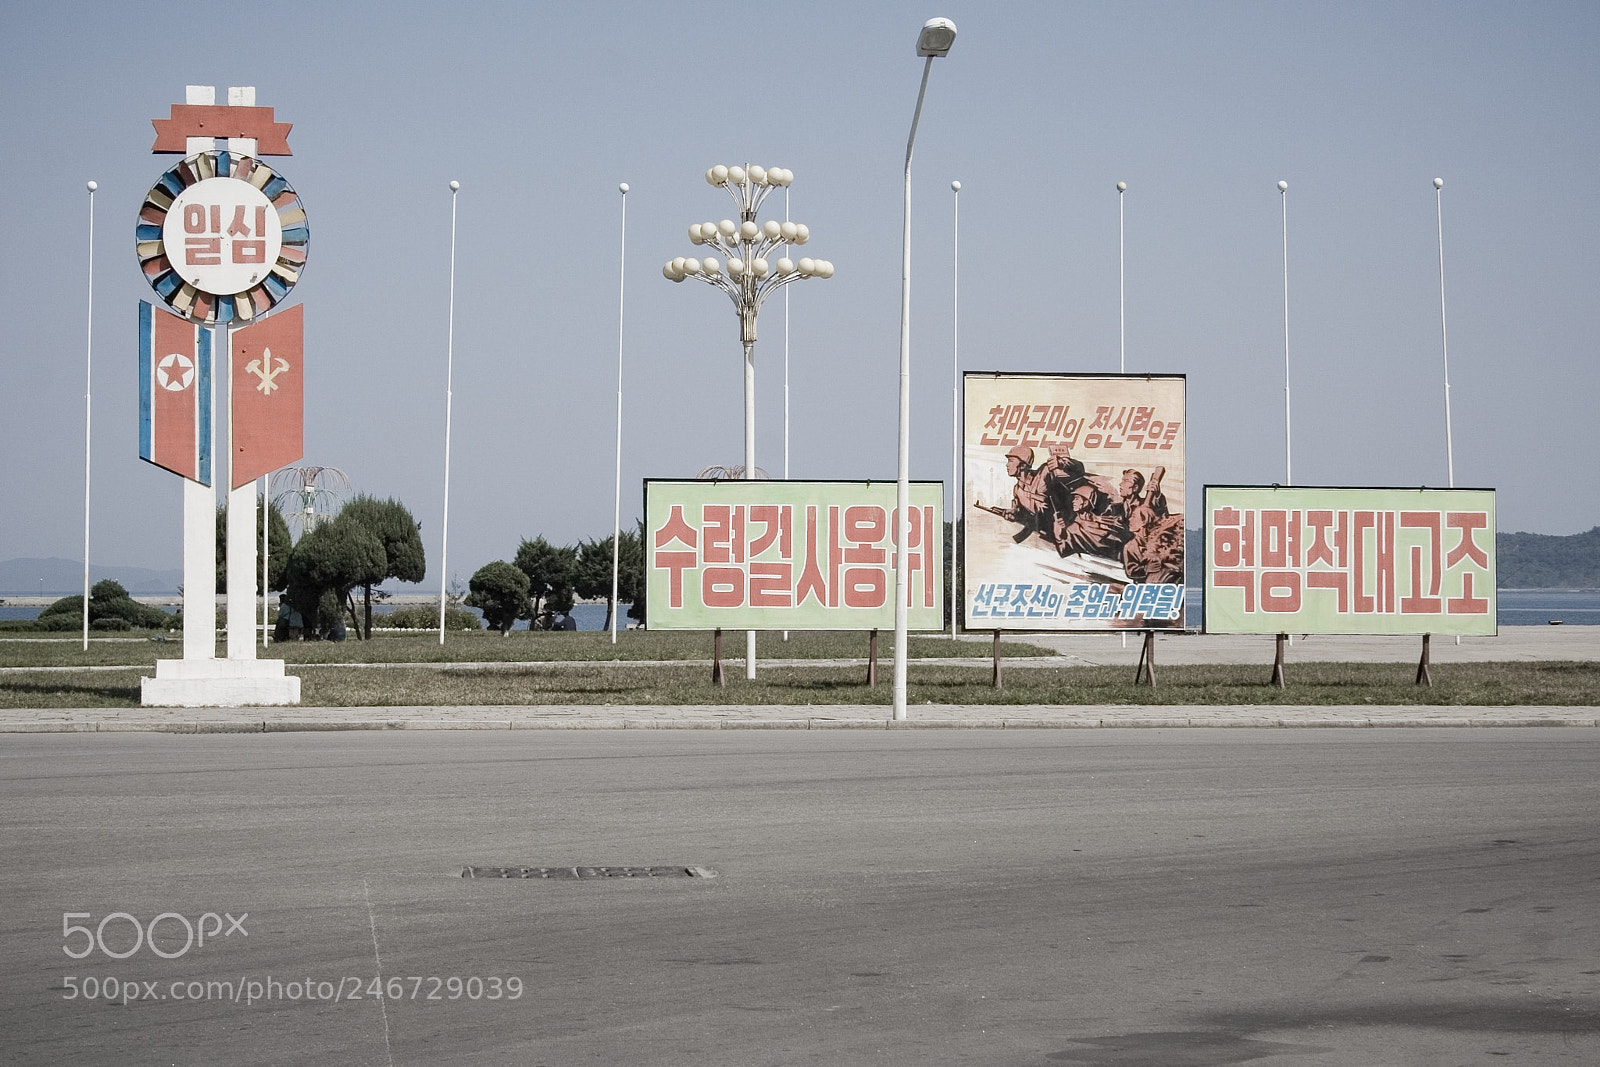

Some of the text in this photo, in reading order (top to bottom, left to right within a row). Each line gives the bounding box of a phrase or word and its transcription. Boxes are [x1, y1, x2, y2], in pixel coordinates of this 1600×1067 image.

[183, 203, 266, 266] 일심
[979, 404, 1182, 450] 천만군민의 정신력으로
[970, 582, 1064, 618] 선군조선의
